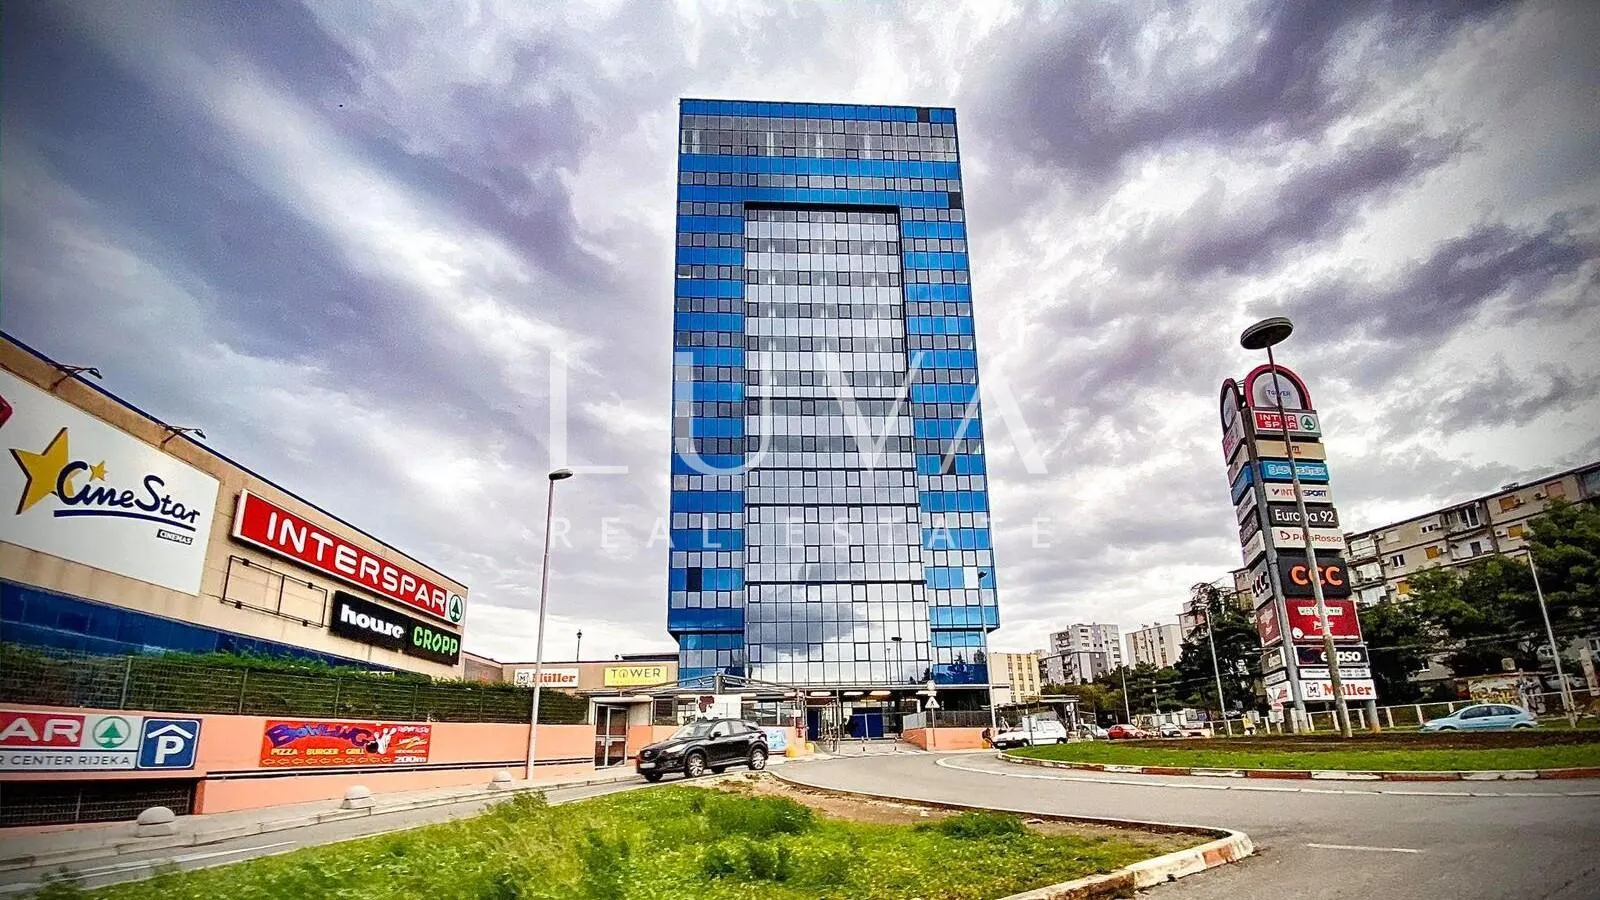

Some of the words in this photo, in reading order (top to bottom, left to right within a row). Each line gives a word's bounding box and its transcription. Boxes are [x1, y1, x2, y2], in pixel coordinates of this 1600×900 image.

[1264, 421, 1297, 429] SPR
[57, 461, 200, 523] CineStar
[1281, 488, 1327, 497] INTSPORT
[1275, 509, 1318, 522] Euroa
[1320, 510, 1335, 523] 92
[159, 530, 192, 544] CINEMAS
[1293, 533, 1342, 543] PiaRosso
[266, 512, 445, 612] INTERSPAR
[413, 626, 458, 655] CROPP
[1320, 649, 1361, 663] epso
[611, 668, 661, 678] TOWER
[11, 755, 72, 766] CENTER
[78, 755, 130, 766] RIJEKA
